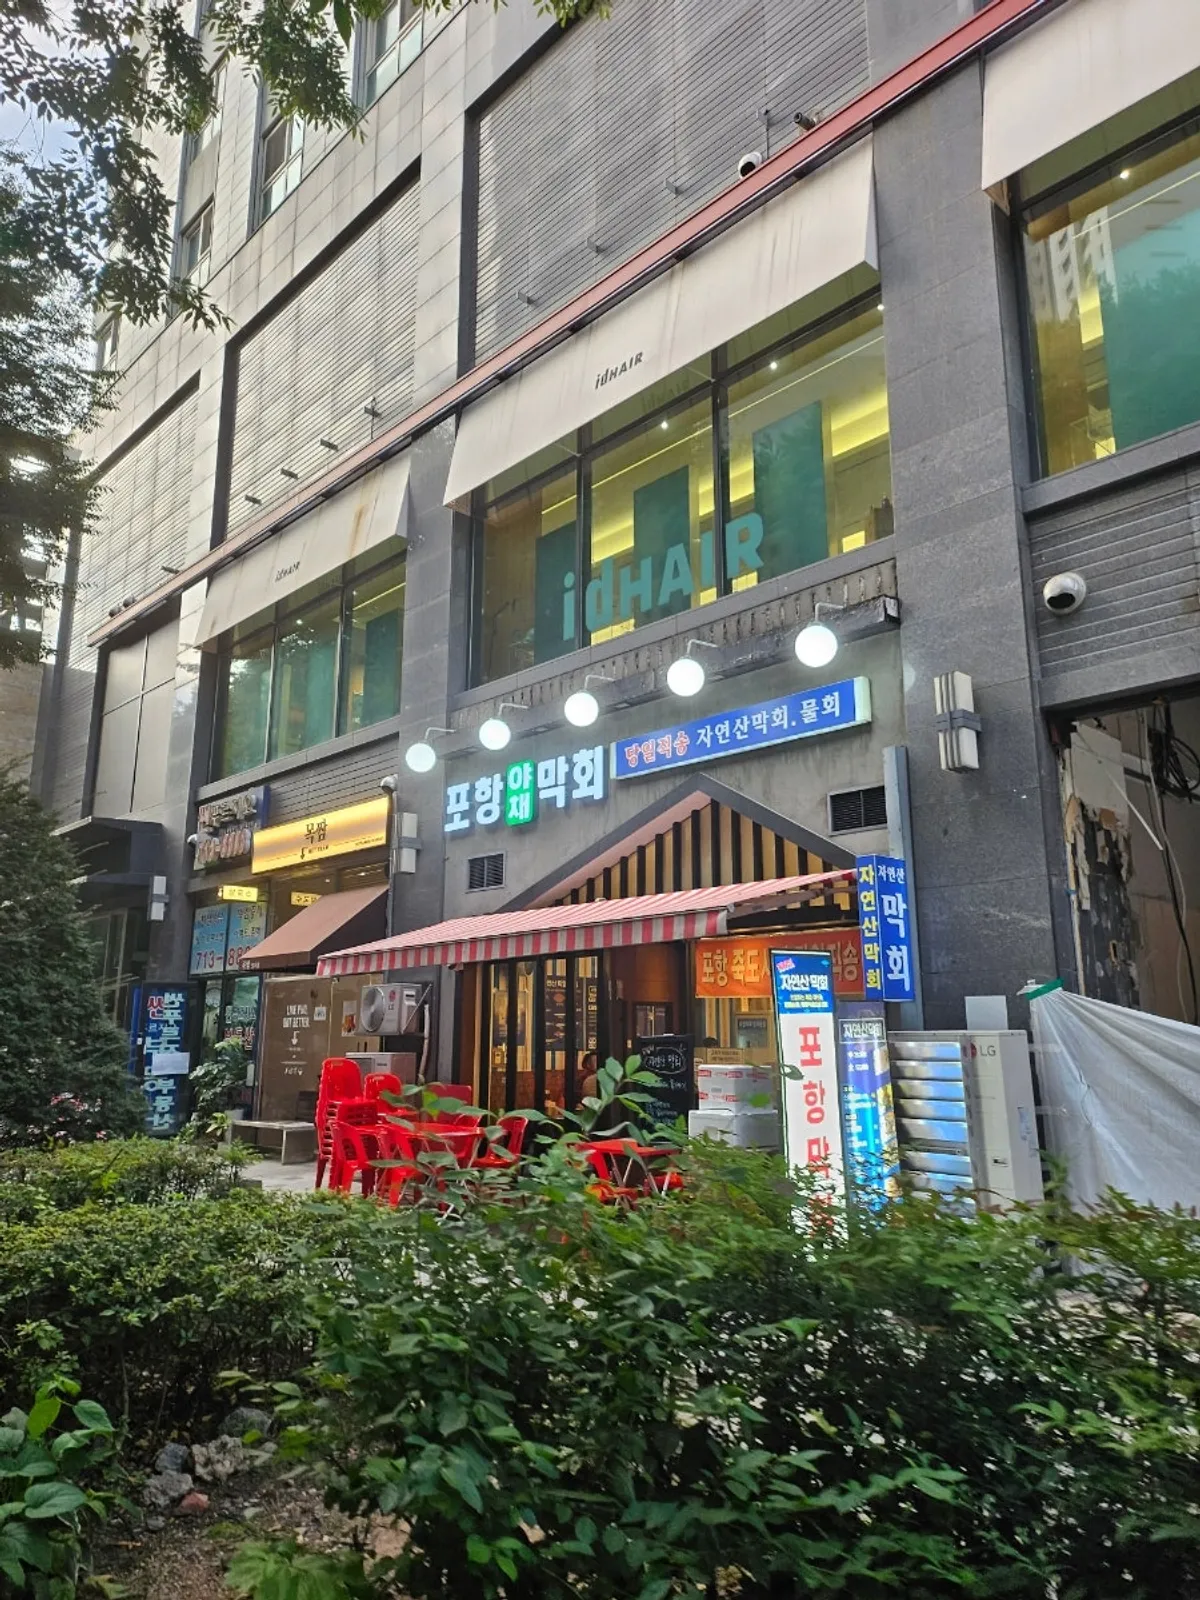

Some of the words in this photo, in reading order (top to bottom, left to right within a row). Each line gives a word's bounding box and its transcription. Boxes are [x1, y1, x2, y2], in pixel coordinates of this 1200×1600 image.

[595, 352, 644, 390] idHAIR
[563, 512, 764, 641] idHAIR
[624, 730, 691, 768] 당일직송
[444, 773, 503, 832] 포항
[537, 745, 604, 808] 막회
[877, 865, 905, 884] 자연산
[859, 864, 881, 990] 자연산막회
[195, 946, 252, 970] 713-88
[702, 950, 728, 987] 포항
[780, 974, 809, 991] 자연산
[810, 974, 829, 991] 막회
[980, 1045, 996, 1056] LG
